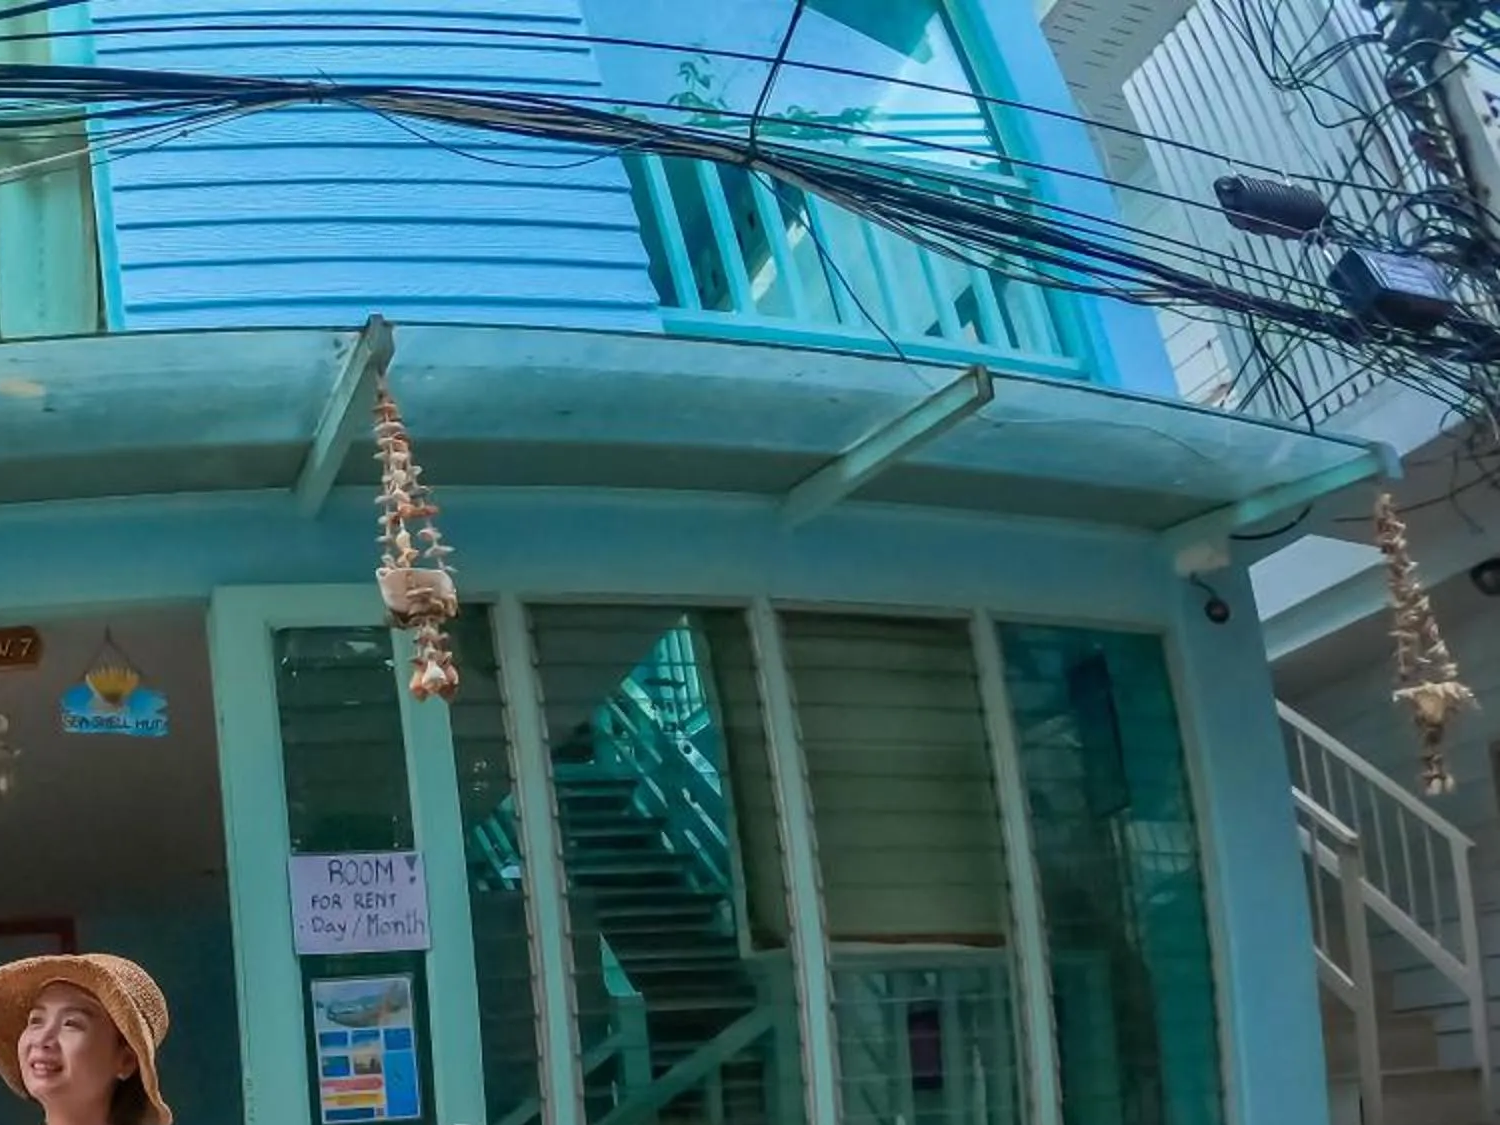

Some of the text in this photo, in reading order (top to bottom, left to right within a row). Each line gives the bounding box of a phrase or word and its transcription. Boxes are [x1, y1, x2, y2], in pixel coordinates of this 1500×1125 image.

[328, 857, 395, 886] ROOM
[311, 891, 397, 911] FOR RENT
